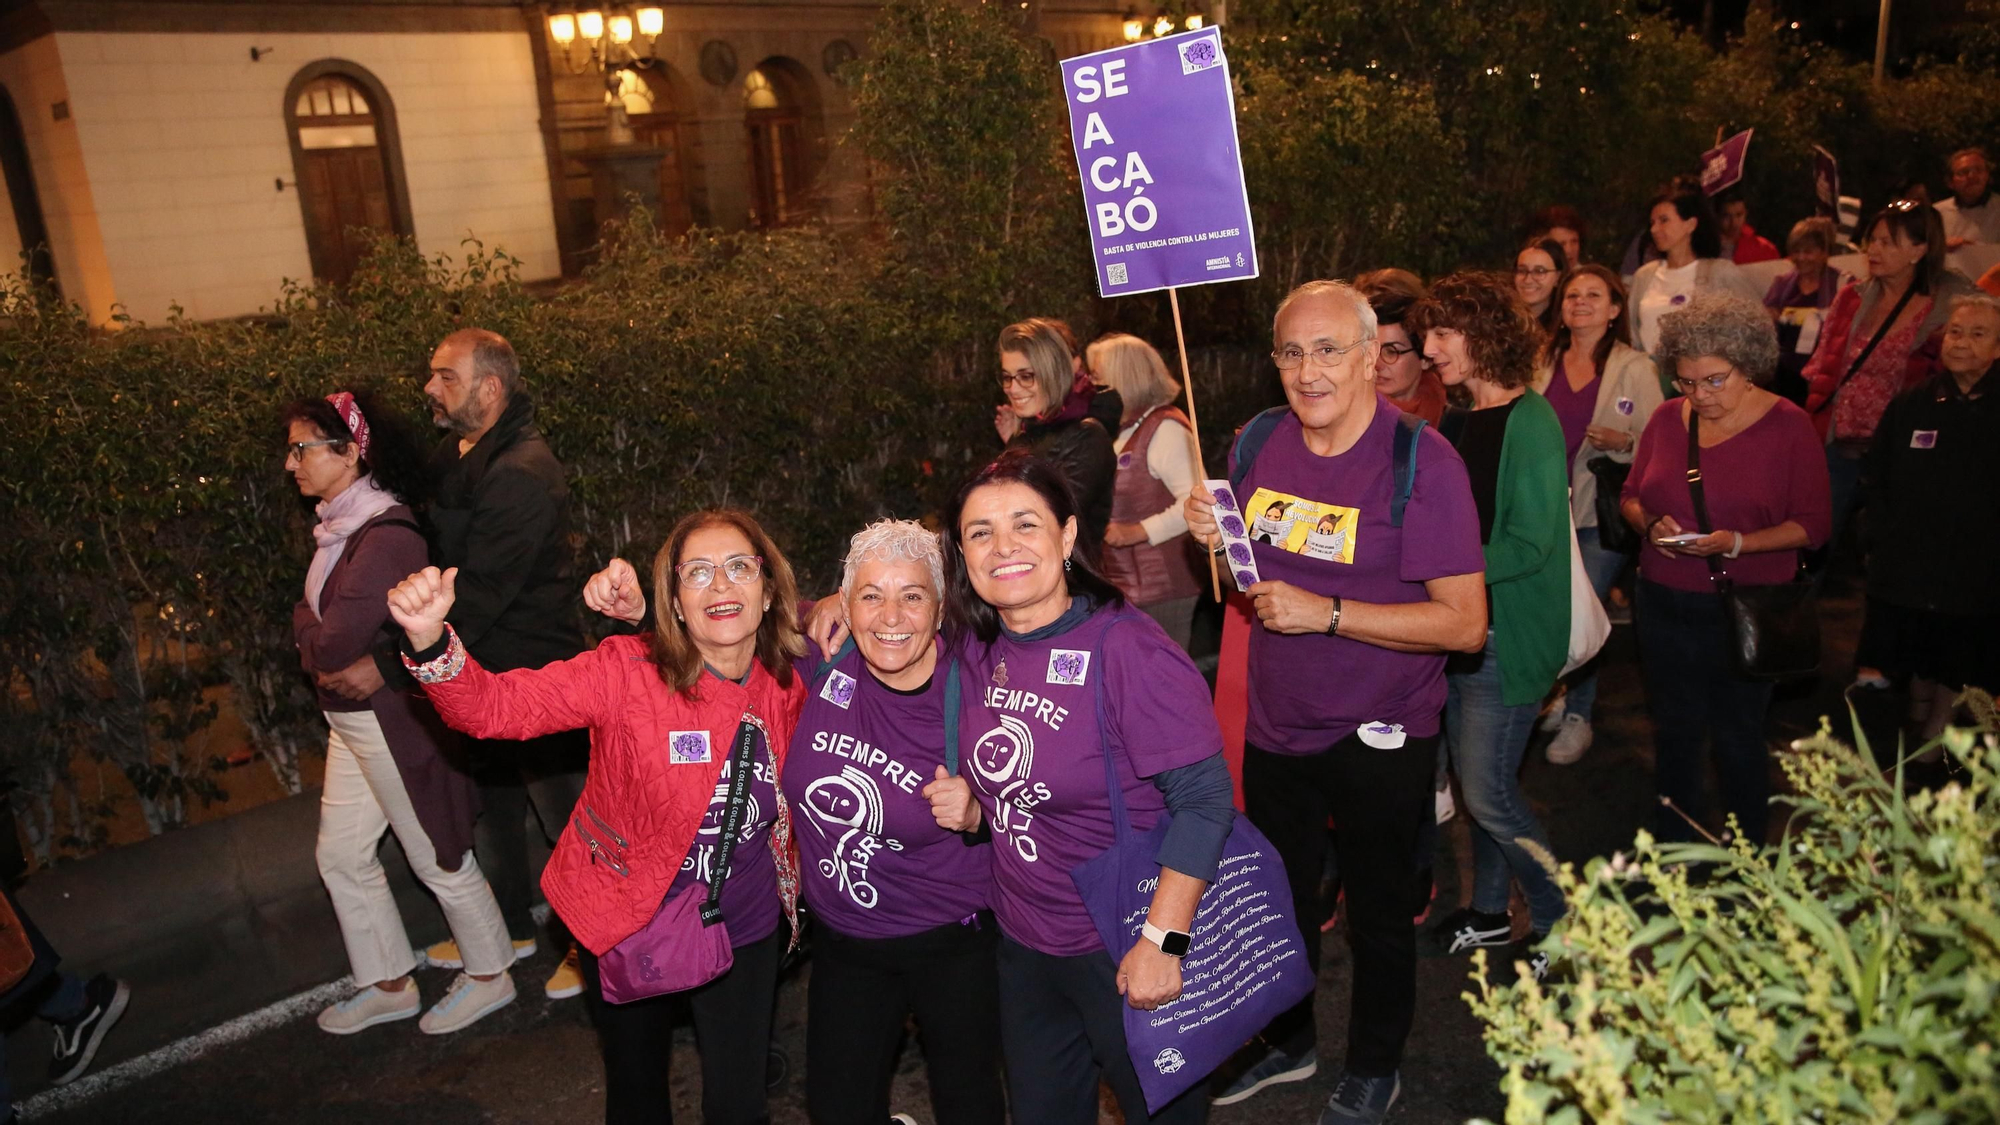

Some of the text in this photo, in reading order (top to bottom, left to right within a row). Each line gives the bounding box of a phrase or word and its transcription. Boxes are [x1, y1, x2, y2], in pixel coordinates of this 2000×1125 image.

[1073, 58, 1129, 103] SE
[1083, 111, 1115, 150] A
[1090, 151, 1154, 192] CA
[1096, 186, 1158, 238] BÓ
[1103, 228, 1240, 256] BASTA DE VIOLENCIA CONTRA LAS MUJERES
[1206, 256, 1230, 266] AMNISTÍA
[742, 734, 751, 759] COLORS
[812, 731, 923, 794] SIEMPRE
[736, 770, 746, 796] COLORS
[728, 806, 738, 831] COLORS
[720, 842, 730, 866] COLORS
[1219, 870, 1239, 886] Audre
[702, 908, 720, 920] COLORS
[1178, 1021, 1200, 1034] Emma
